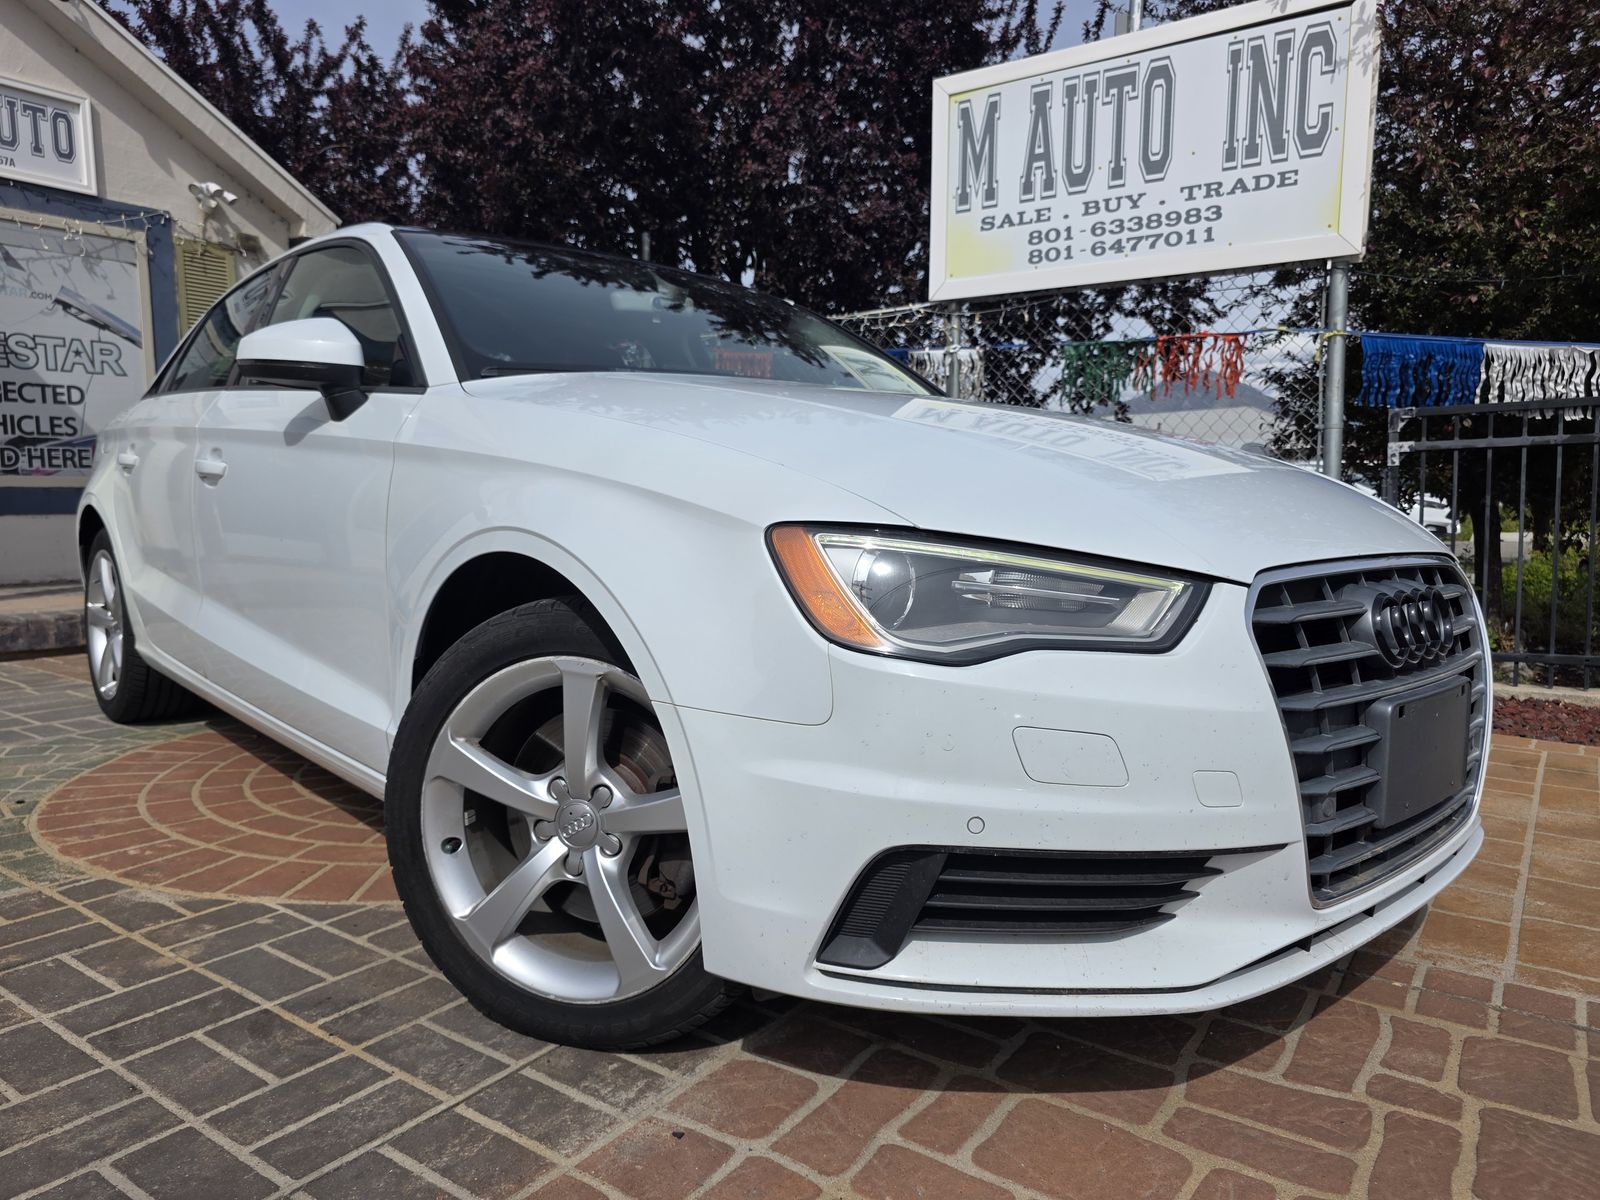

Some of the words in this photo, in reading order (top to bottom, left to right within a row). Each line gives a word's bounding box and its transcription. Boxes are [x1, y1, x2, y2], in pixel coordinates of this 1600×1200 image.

[955, 92, 1001, 213] M
[1019, 55, 1176, 202] AUTO
[1222, 21, 1337, 171] INC
[980, 207, 1051, 232] SALE
[1081, 192, 1147, 217] BUY
[1180, 169, 1299, 202] TRADE
[1027, 205, 1223, 246] 801-6338983
[1027, 226, 1215, 265] 801-6477011
[0, 381, 86, 406] ECTED
[27, 447, 92, 469] HERE
